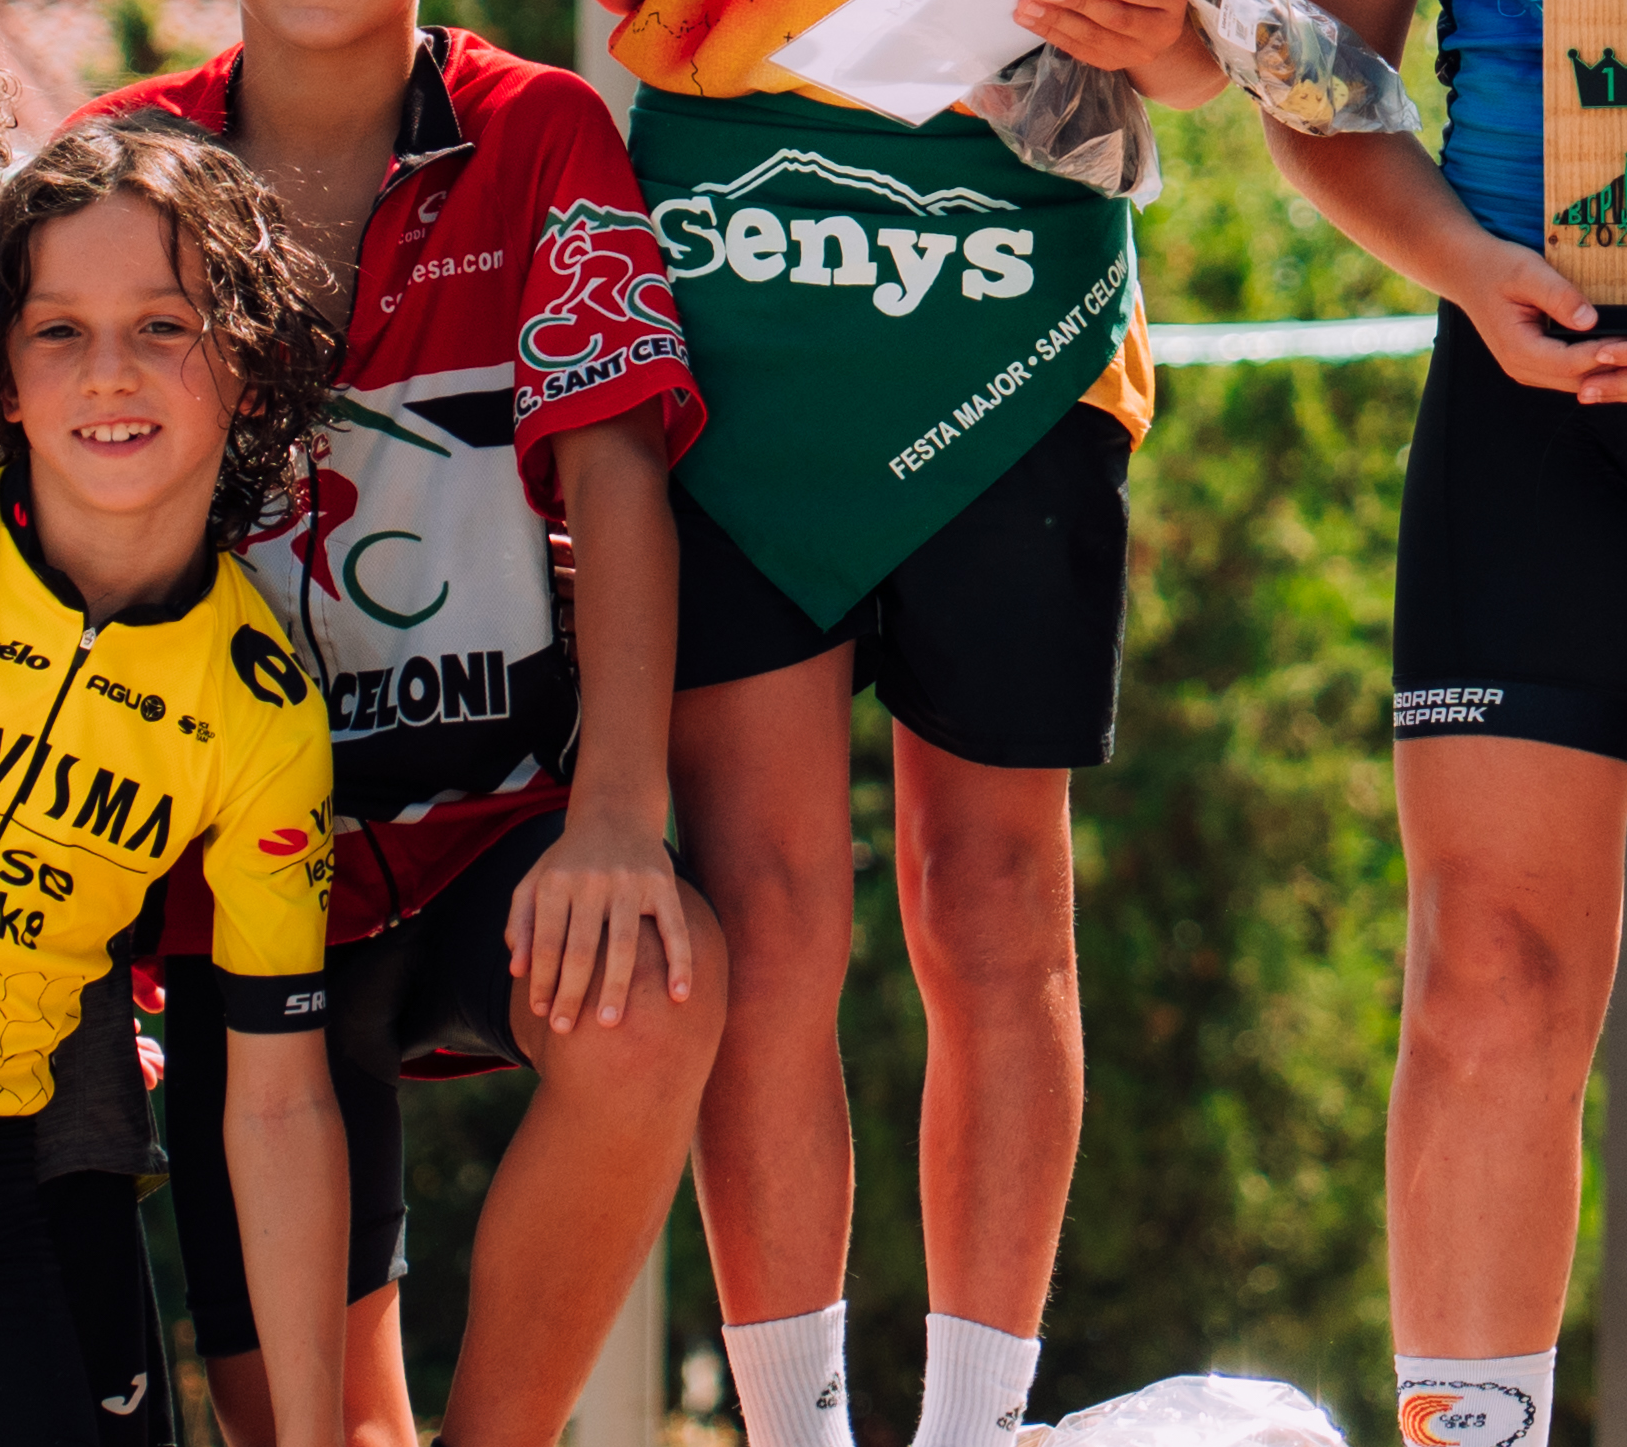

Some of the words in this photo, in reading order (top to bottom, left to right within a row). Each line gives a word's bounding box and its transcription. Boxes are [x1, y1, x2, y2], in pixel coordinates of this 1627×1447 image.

[1601, 66, 1615, 103] 1
[543, 346, 628, 402] SANT
[888, 420, 962, 481] FESTA
[952, 361, 1033, 431] MAJOR
[1034, 305, 1088, 361] SANT
